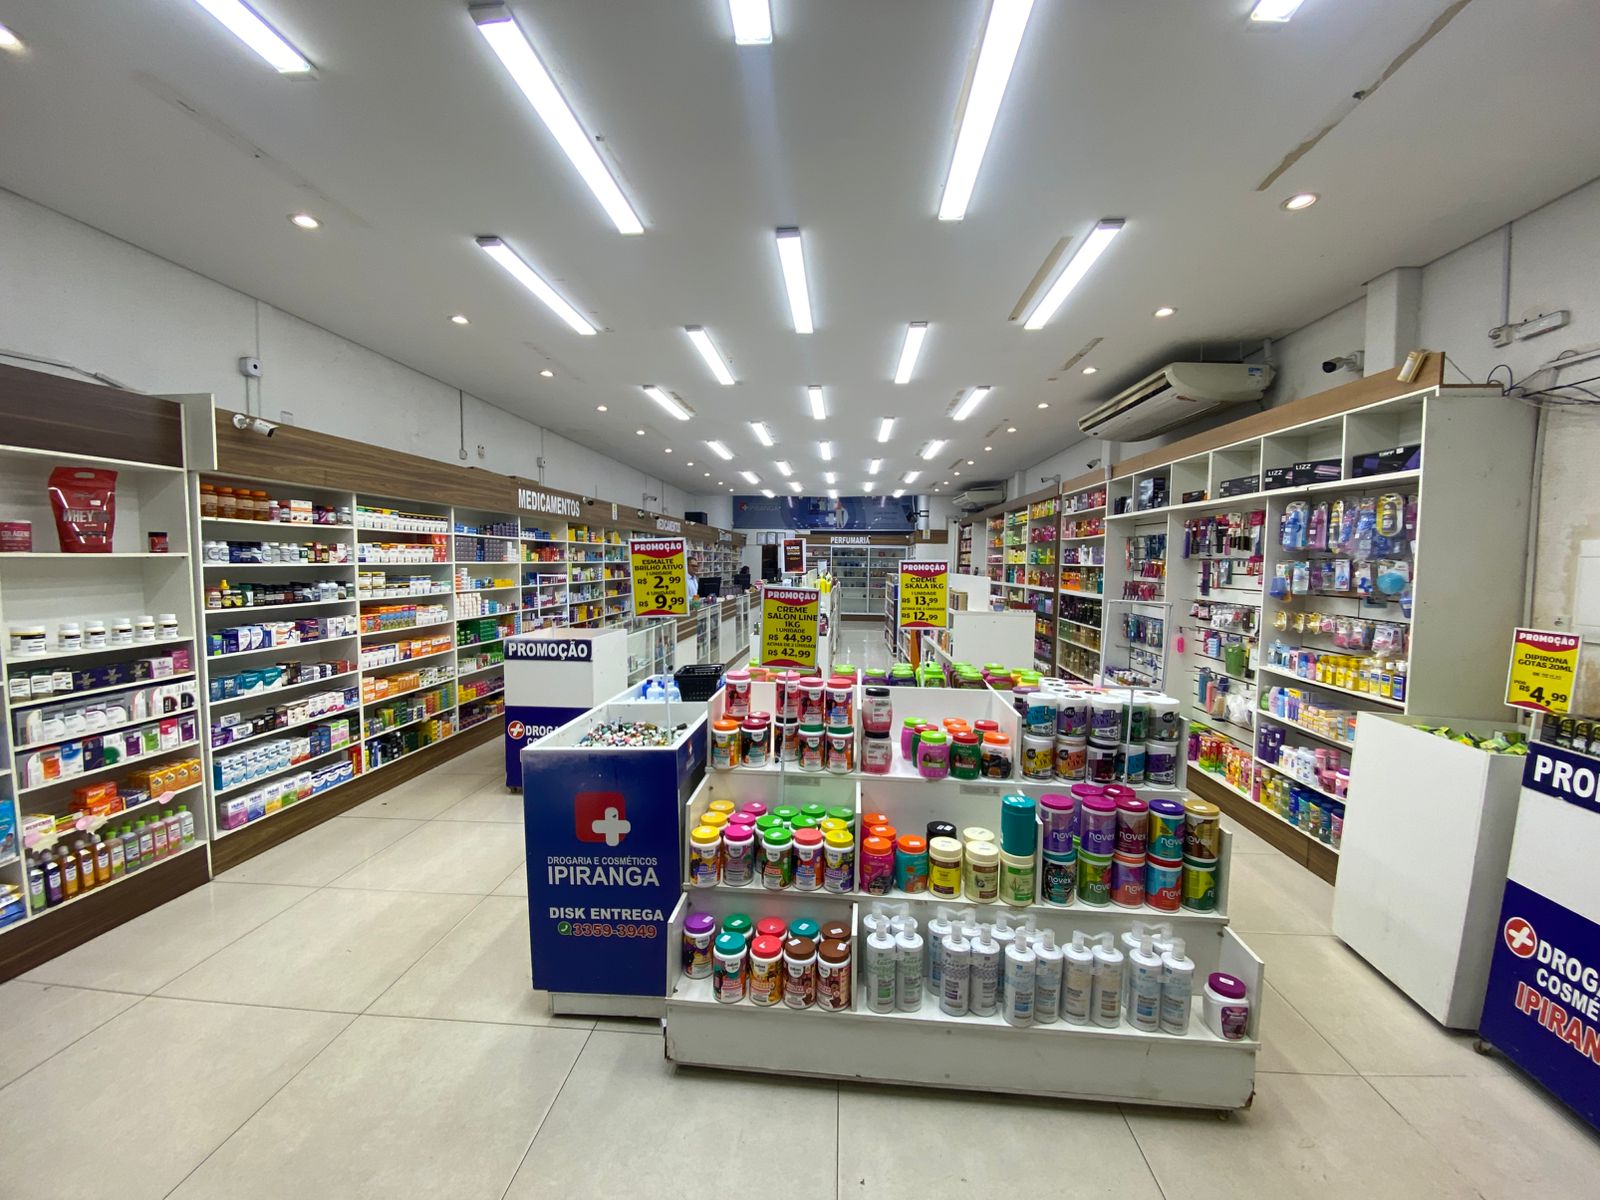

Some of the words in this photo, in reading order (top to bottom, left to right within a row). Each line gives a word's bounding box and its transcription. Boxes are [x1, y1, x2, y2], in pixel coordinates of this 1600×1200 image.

[518, 488, 580, 518] MEDICAMENTOS
[64, 510, 94, 522] WHEY
[830, 536, 870, 544] PERFUMARIA
[634, 542, 682, 552] PROMOÇÃO
[903, 563, 946, 572] PROMOÇÃO
[768, 590, 816, 602] PROMOÇÃO
[915, 596, 938, 606] 13,99
[914, 612, 938, 622] 12,99
[783, 634, 812, 643] 44,99
[1519, 632, 1576, 647] PROMOÇÃO
[508, 640, 588, 660] PROMOÇÃO
[781, 648, 810, 658] 42,99
[1518, 658, 1547, 668] GOTAS
[1548, 664, 1572, 672] 20ML
[1525, 654, 1568, 664] DIPIRONA
[1519, 684, 1530, 692] R$
[1530, 686, 1568, 706] 4,99
[1534, 754, 1600, 804] PRO
[548, 856, 592, 864] DROGARIA
[594, 856, 600, 864] E
[602, 856, 658, 866] COSMÉTICOS
[548, 866, 660, 886] IPIRANGA
[550, 907, 586, 919] DISK
[590, 908, 664, 921] ENTREGA
[573, 922, 657, 938] 3359-3949
[1537, 939, 1600, 998] DROG
